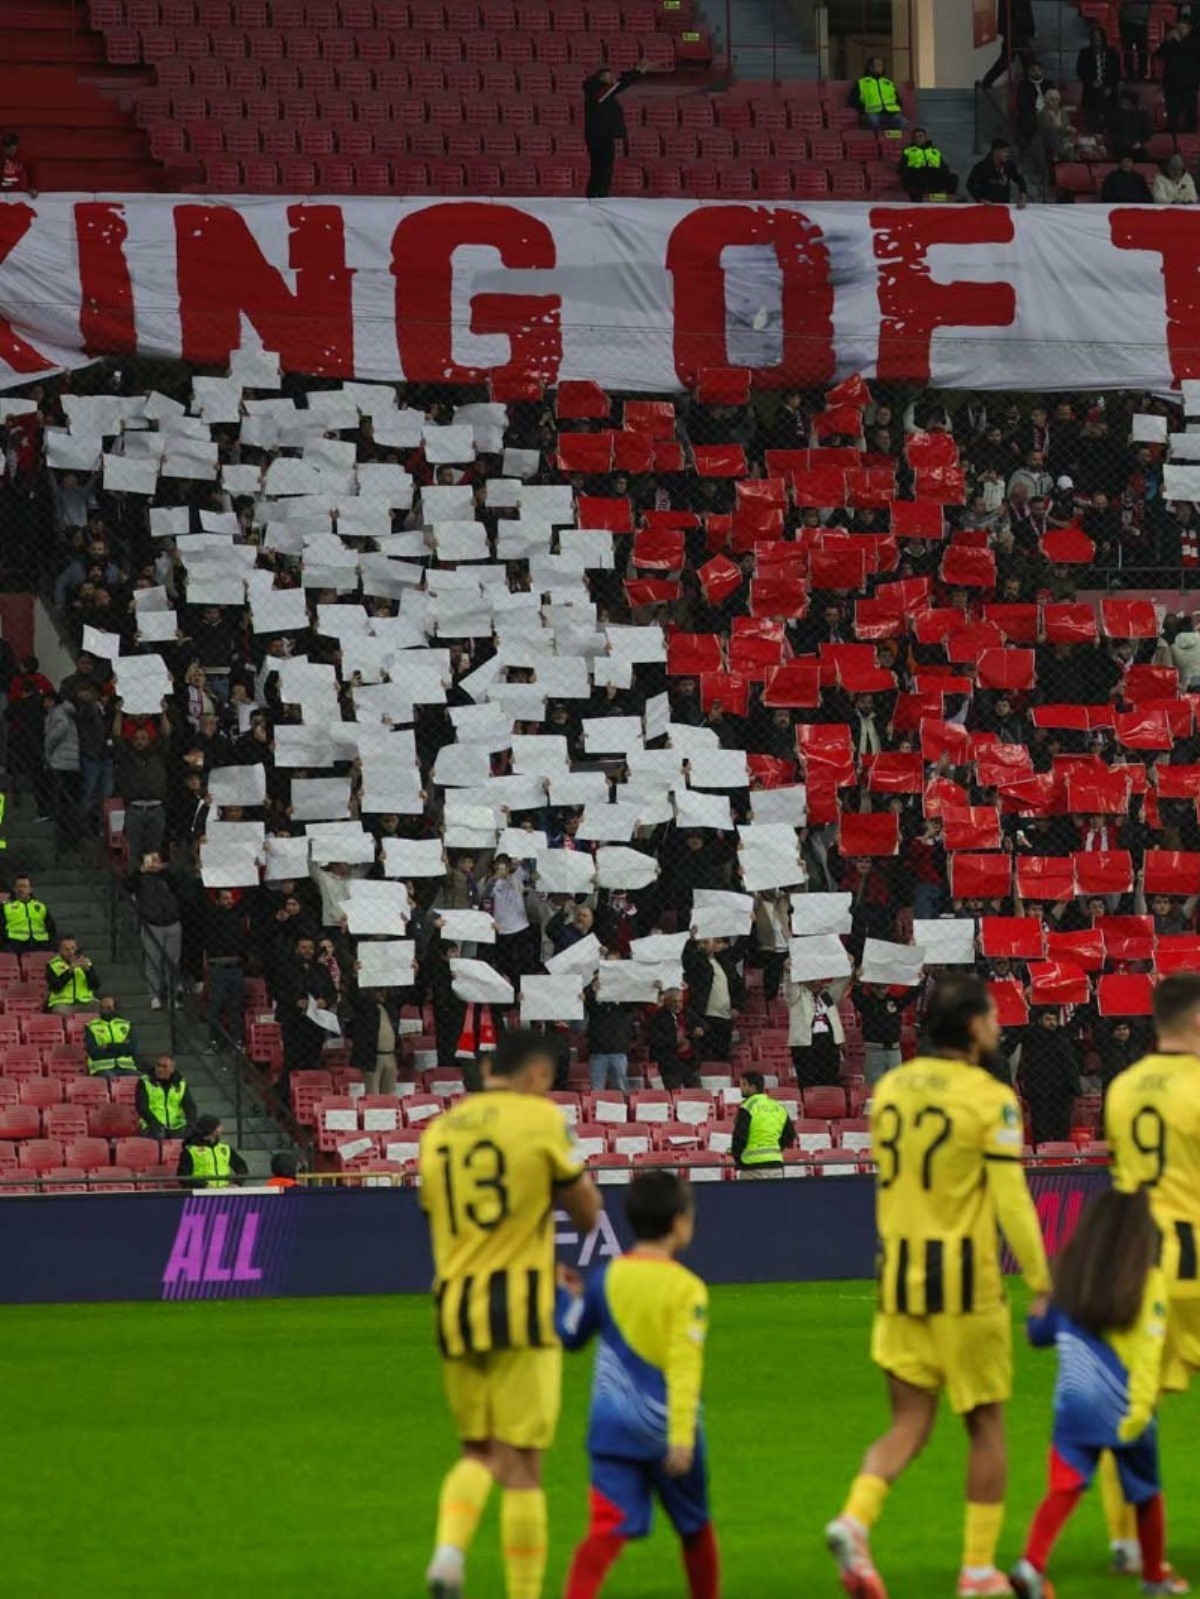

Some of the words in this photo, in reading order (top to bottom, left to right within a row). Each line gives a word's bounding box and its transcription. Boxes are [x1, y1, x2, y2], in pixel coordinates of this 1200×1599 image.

[666, 204, 1015, 390] OF
[436, 1139, 509, 1237] 13
[879, 1103, 951, 1190] 37
[1132, 1106, 1166, 1187] 9
[162, 1212, 264, 1282] ALL
